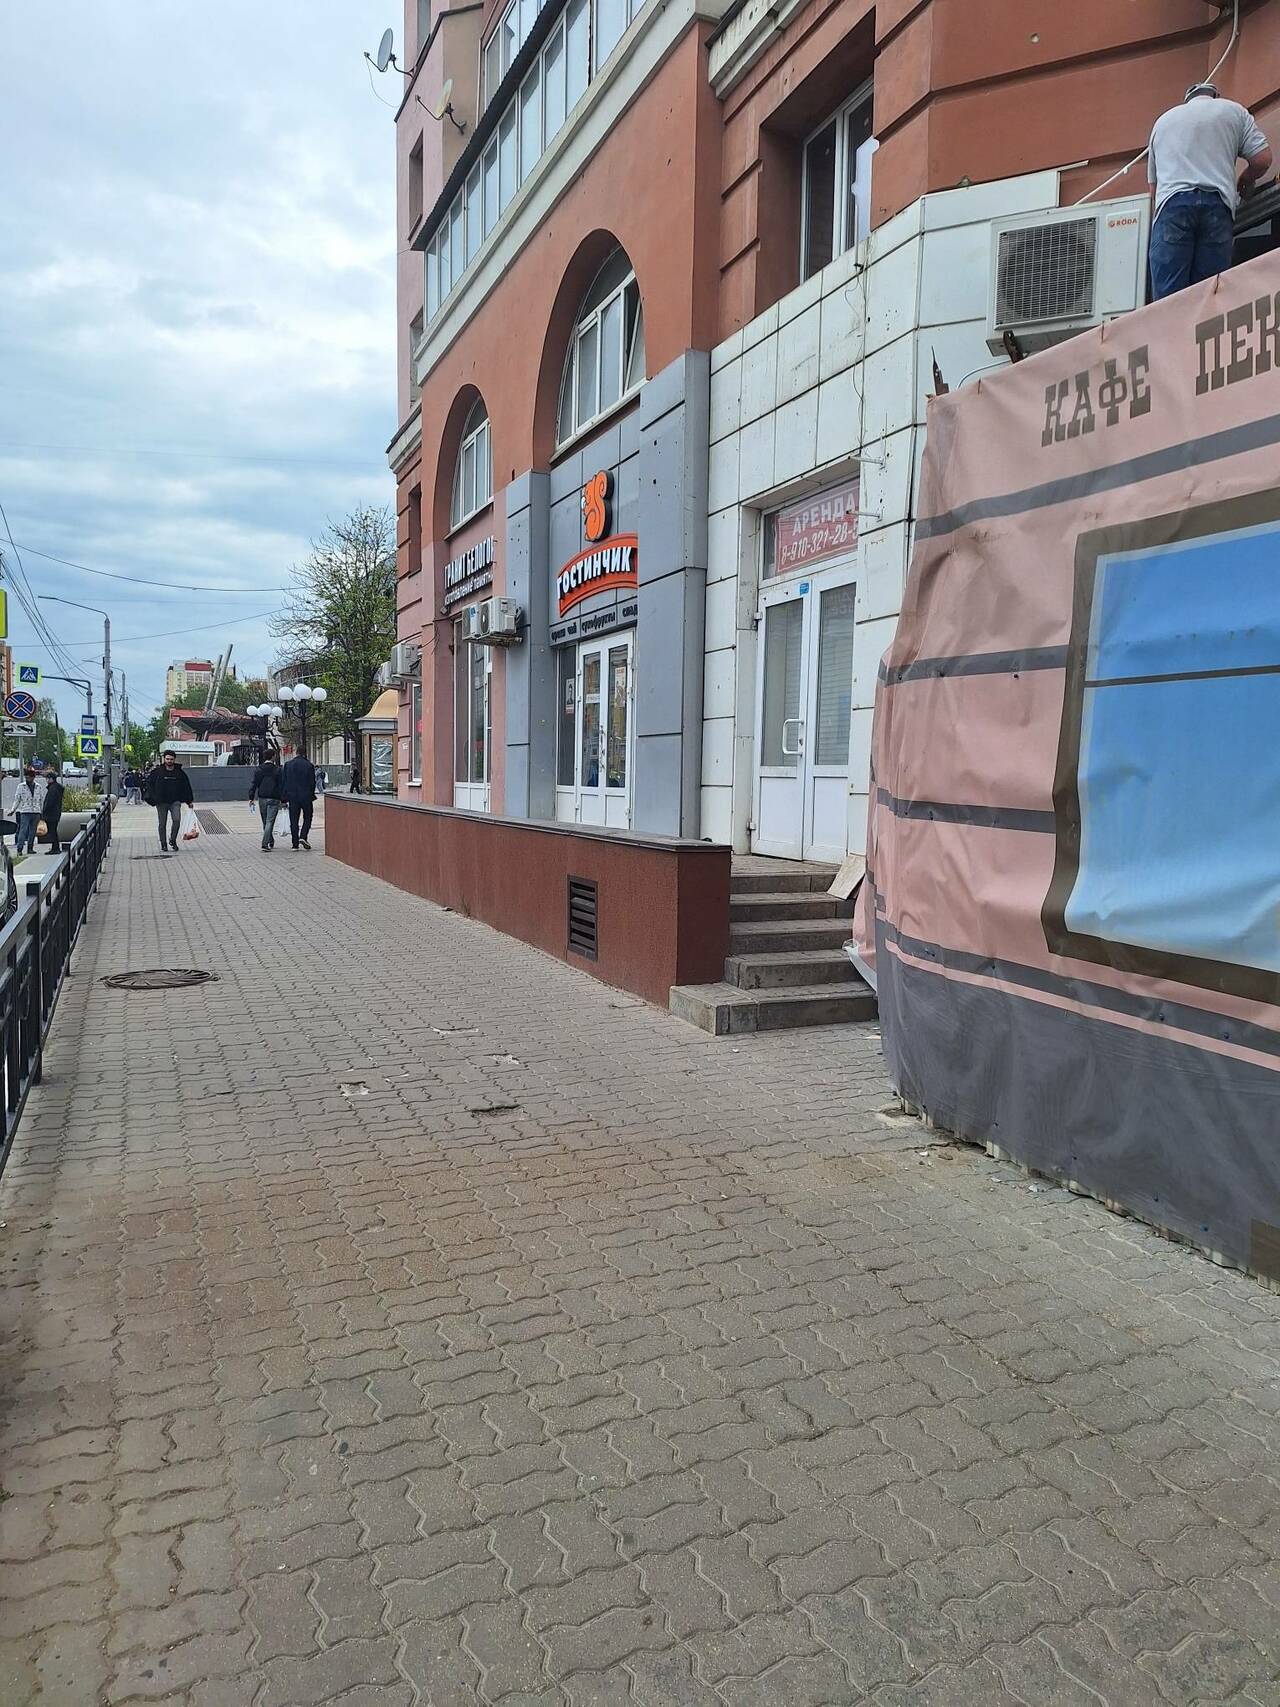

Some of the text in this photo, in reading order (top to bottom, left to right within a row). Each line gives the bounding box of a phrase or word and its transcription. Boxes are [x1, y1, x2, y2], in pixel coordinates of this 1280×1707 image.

[1042, 344, 1151, 448] КАФЕ
[792, 493, 856, 537] АРЕНДА
[556, 546, 633, 600] ГОСТИНЧИК
